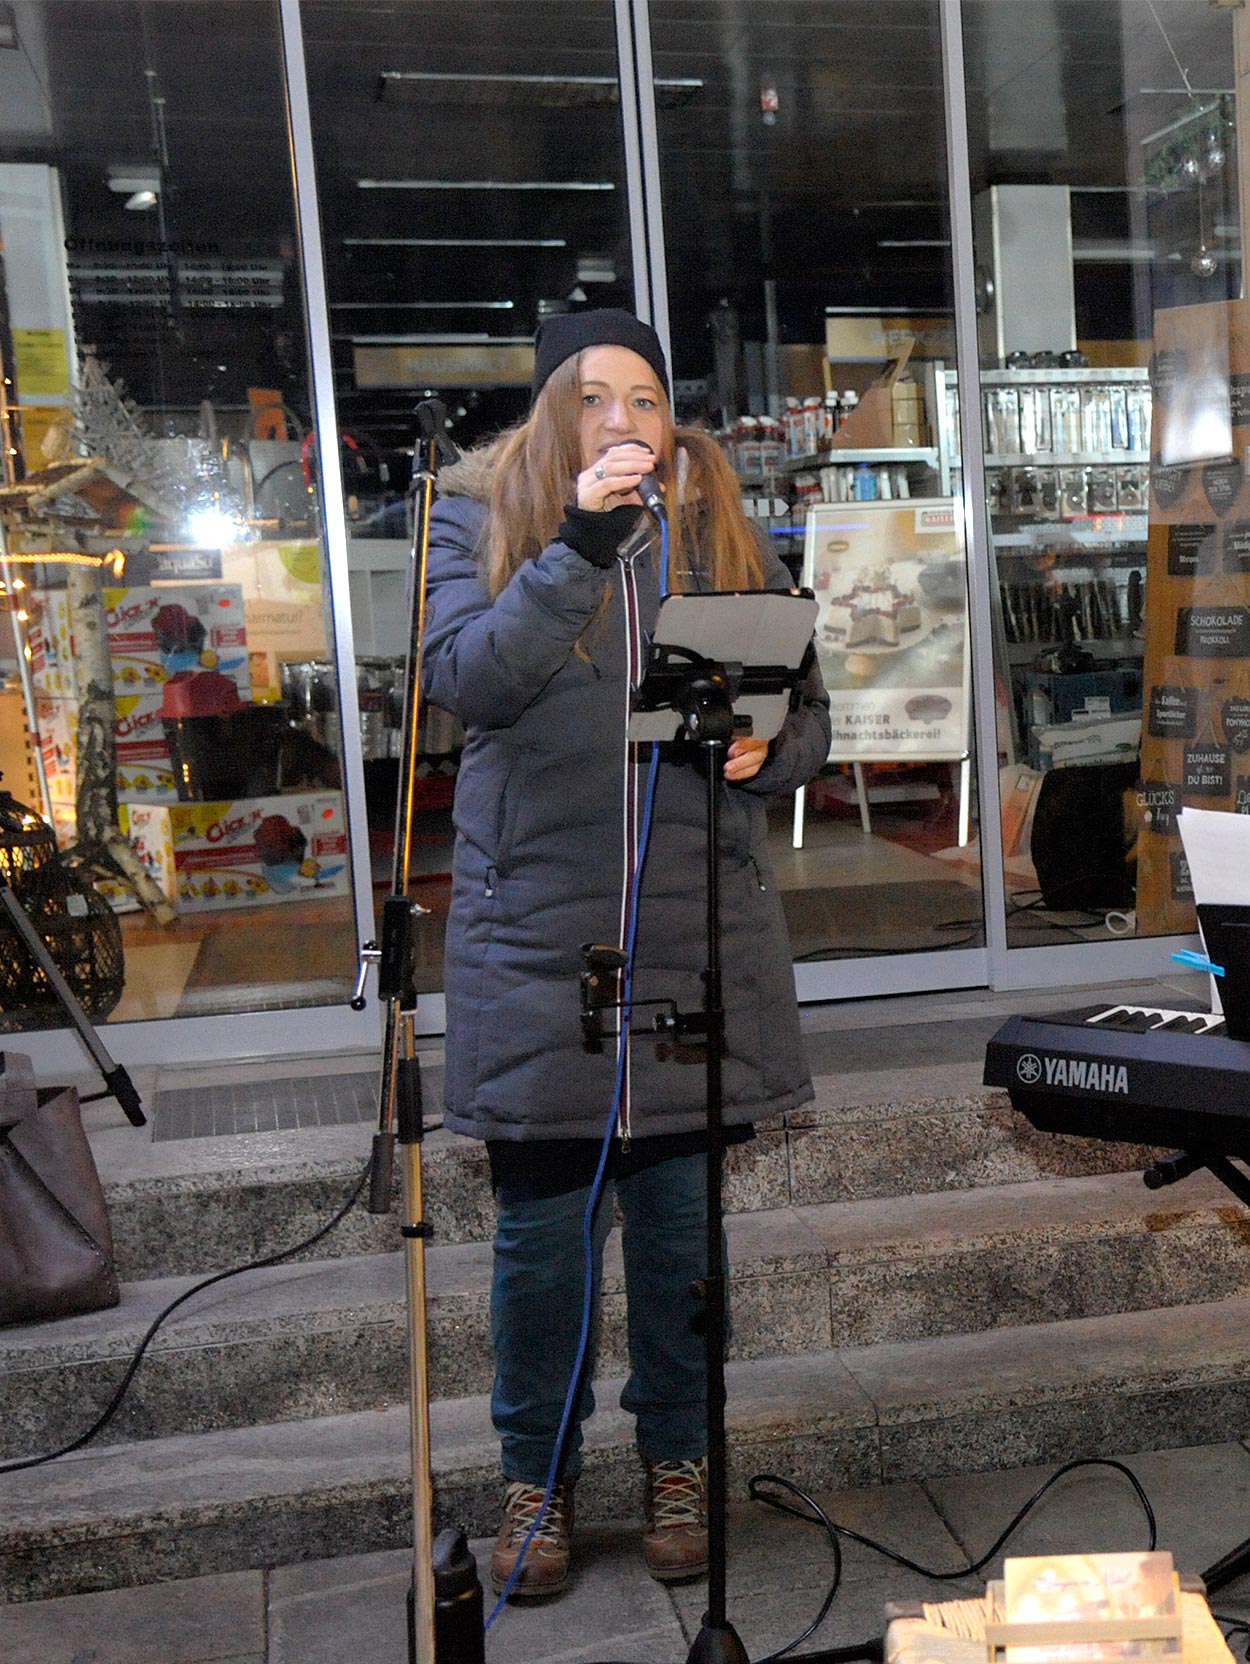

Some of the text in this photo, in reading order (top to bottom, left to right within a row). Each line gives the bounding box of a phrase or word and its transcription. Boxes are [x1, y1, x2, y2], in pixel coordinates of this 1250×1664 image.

[1190, 615, 1244, 627] SCHOKOLADE
[845, 715, 890, 726] KAISER
[832, 728, 942, 741] ihnachtsbäckerei!
[1187, 754, 1226, 763] ZUHAUSE
[1187, 775, 1223, 785] DU BIST!
[1044, 1057, 1129, 1094] YAMAHA
